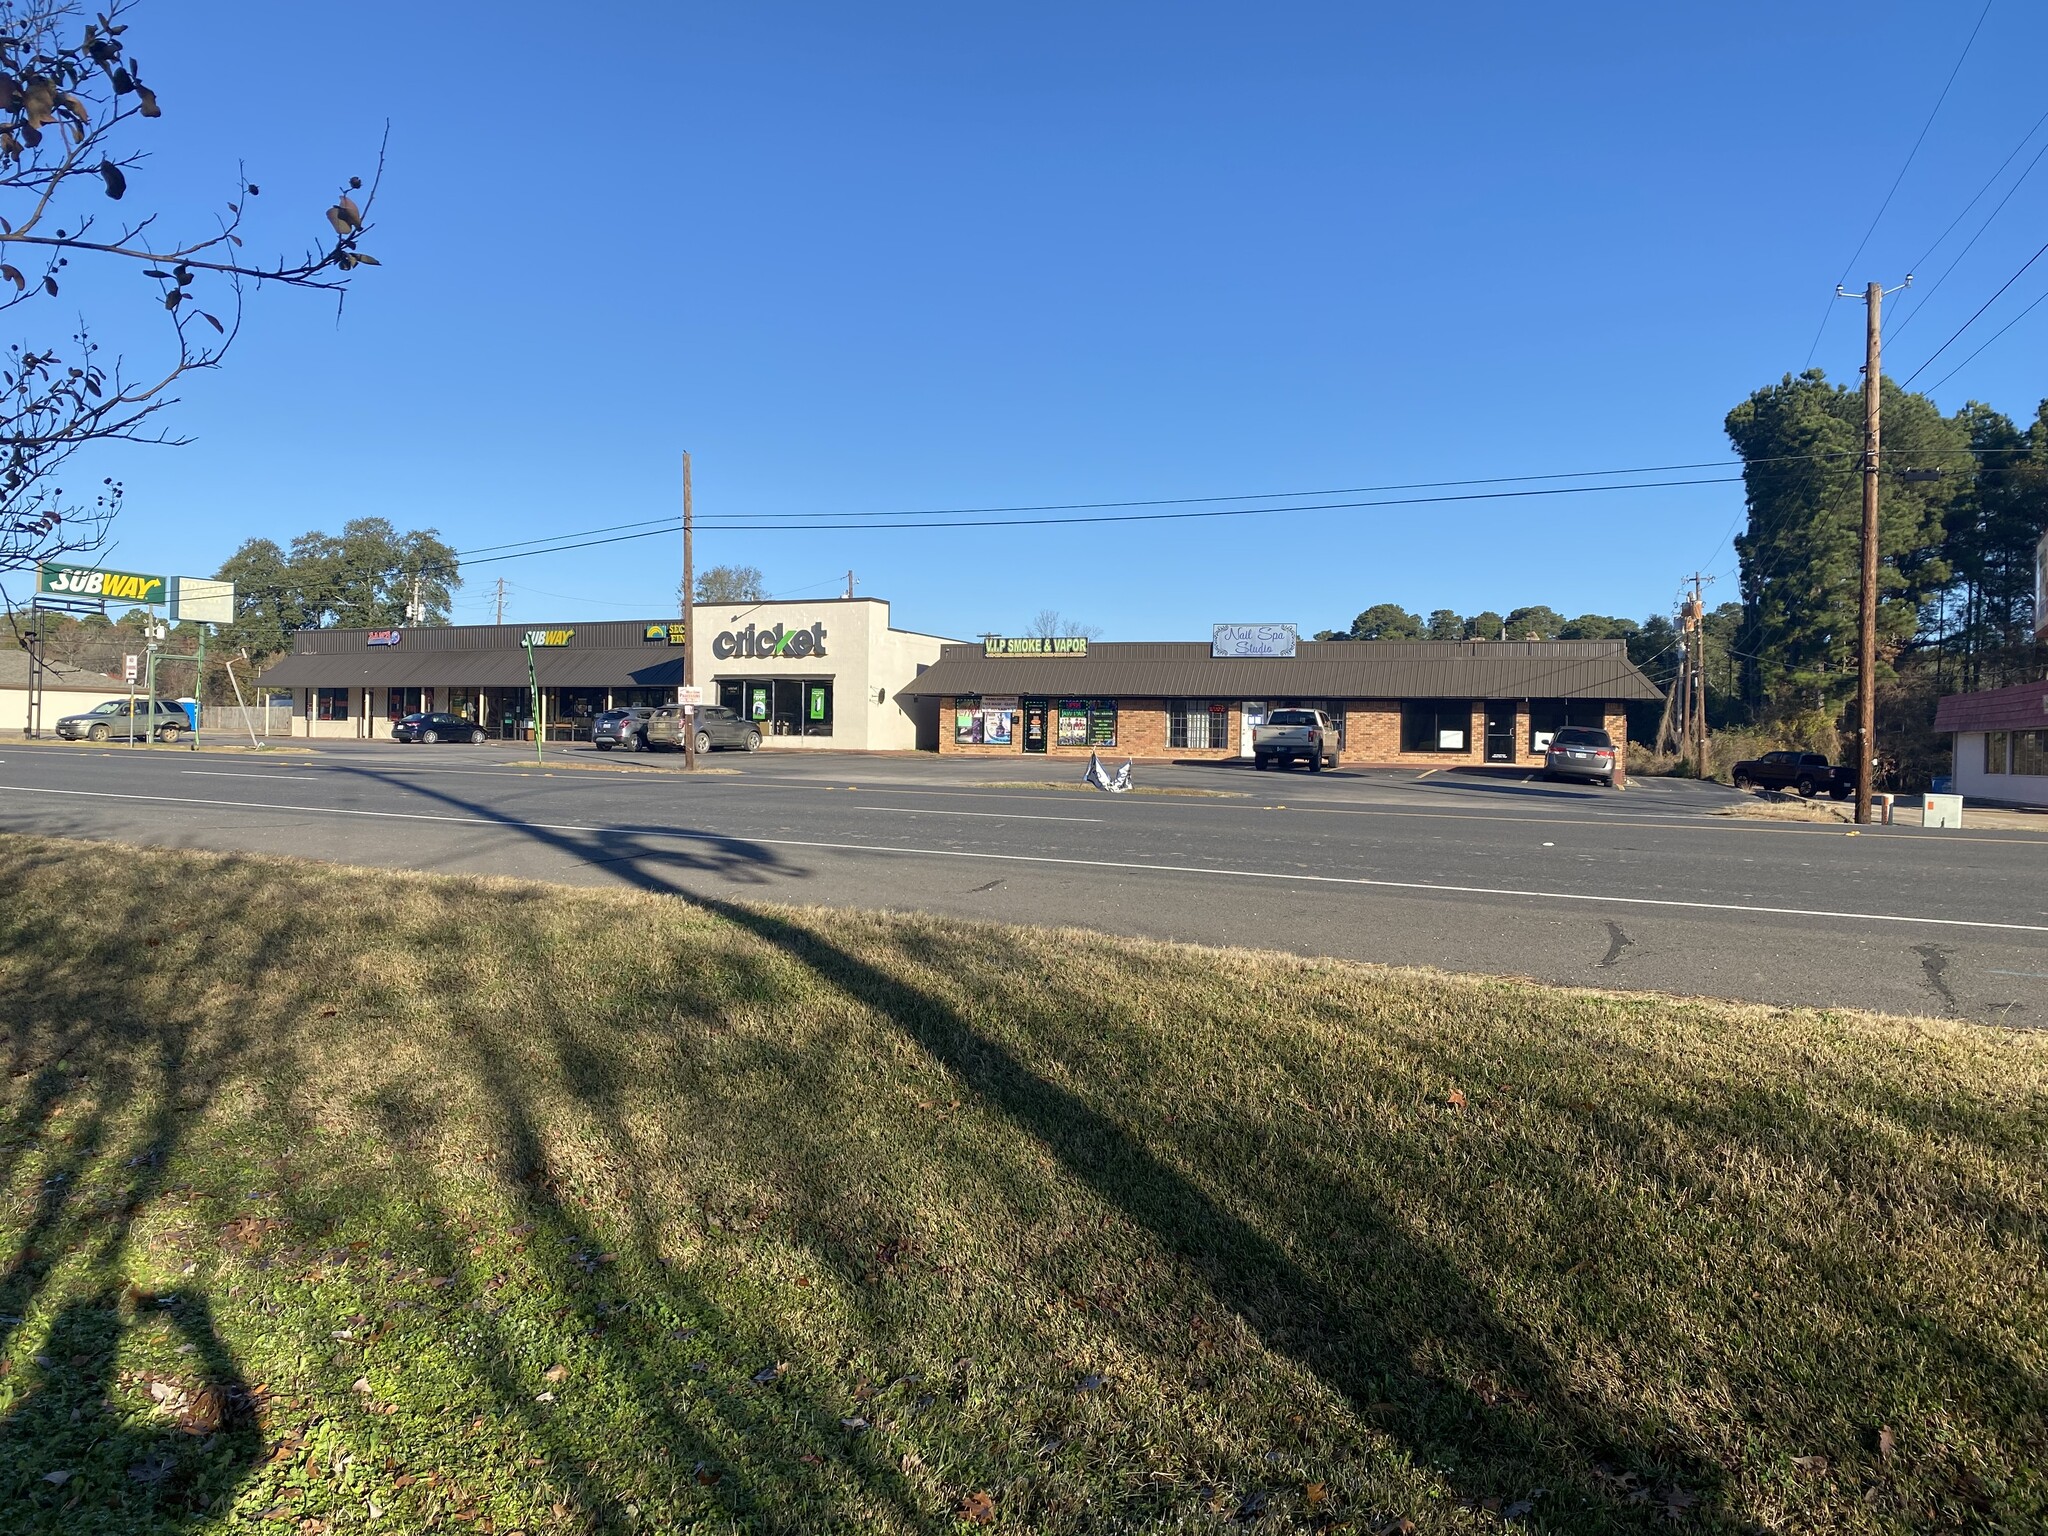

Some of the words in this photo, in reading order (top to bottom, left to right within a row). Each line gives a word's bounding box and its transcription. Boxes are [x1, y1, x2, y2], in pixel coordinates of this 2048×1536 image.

[49, 569, 161, 599] SUBWAY
[521, 628, 575, 645] SUBWAY
[712, 622, 827, 659] cricket
[1224, 627, 1252, 640] Nail
[1258, 627, 1285, 642] Spa
[986, 639, 1005, 652] V.I.P
[1008, 639, 1042, 652] SMOKE
[1044, 638, 1051, 652] &
[1054, 638, 1087, 652] VAPOR
[1236, 642, 1272, 653] Studio
